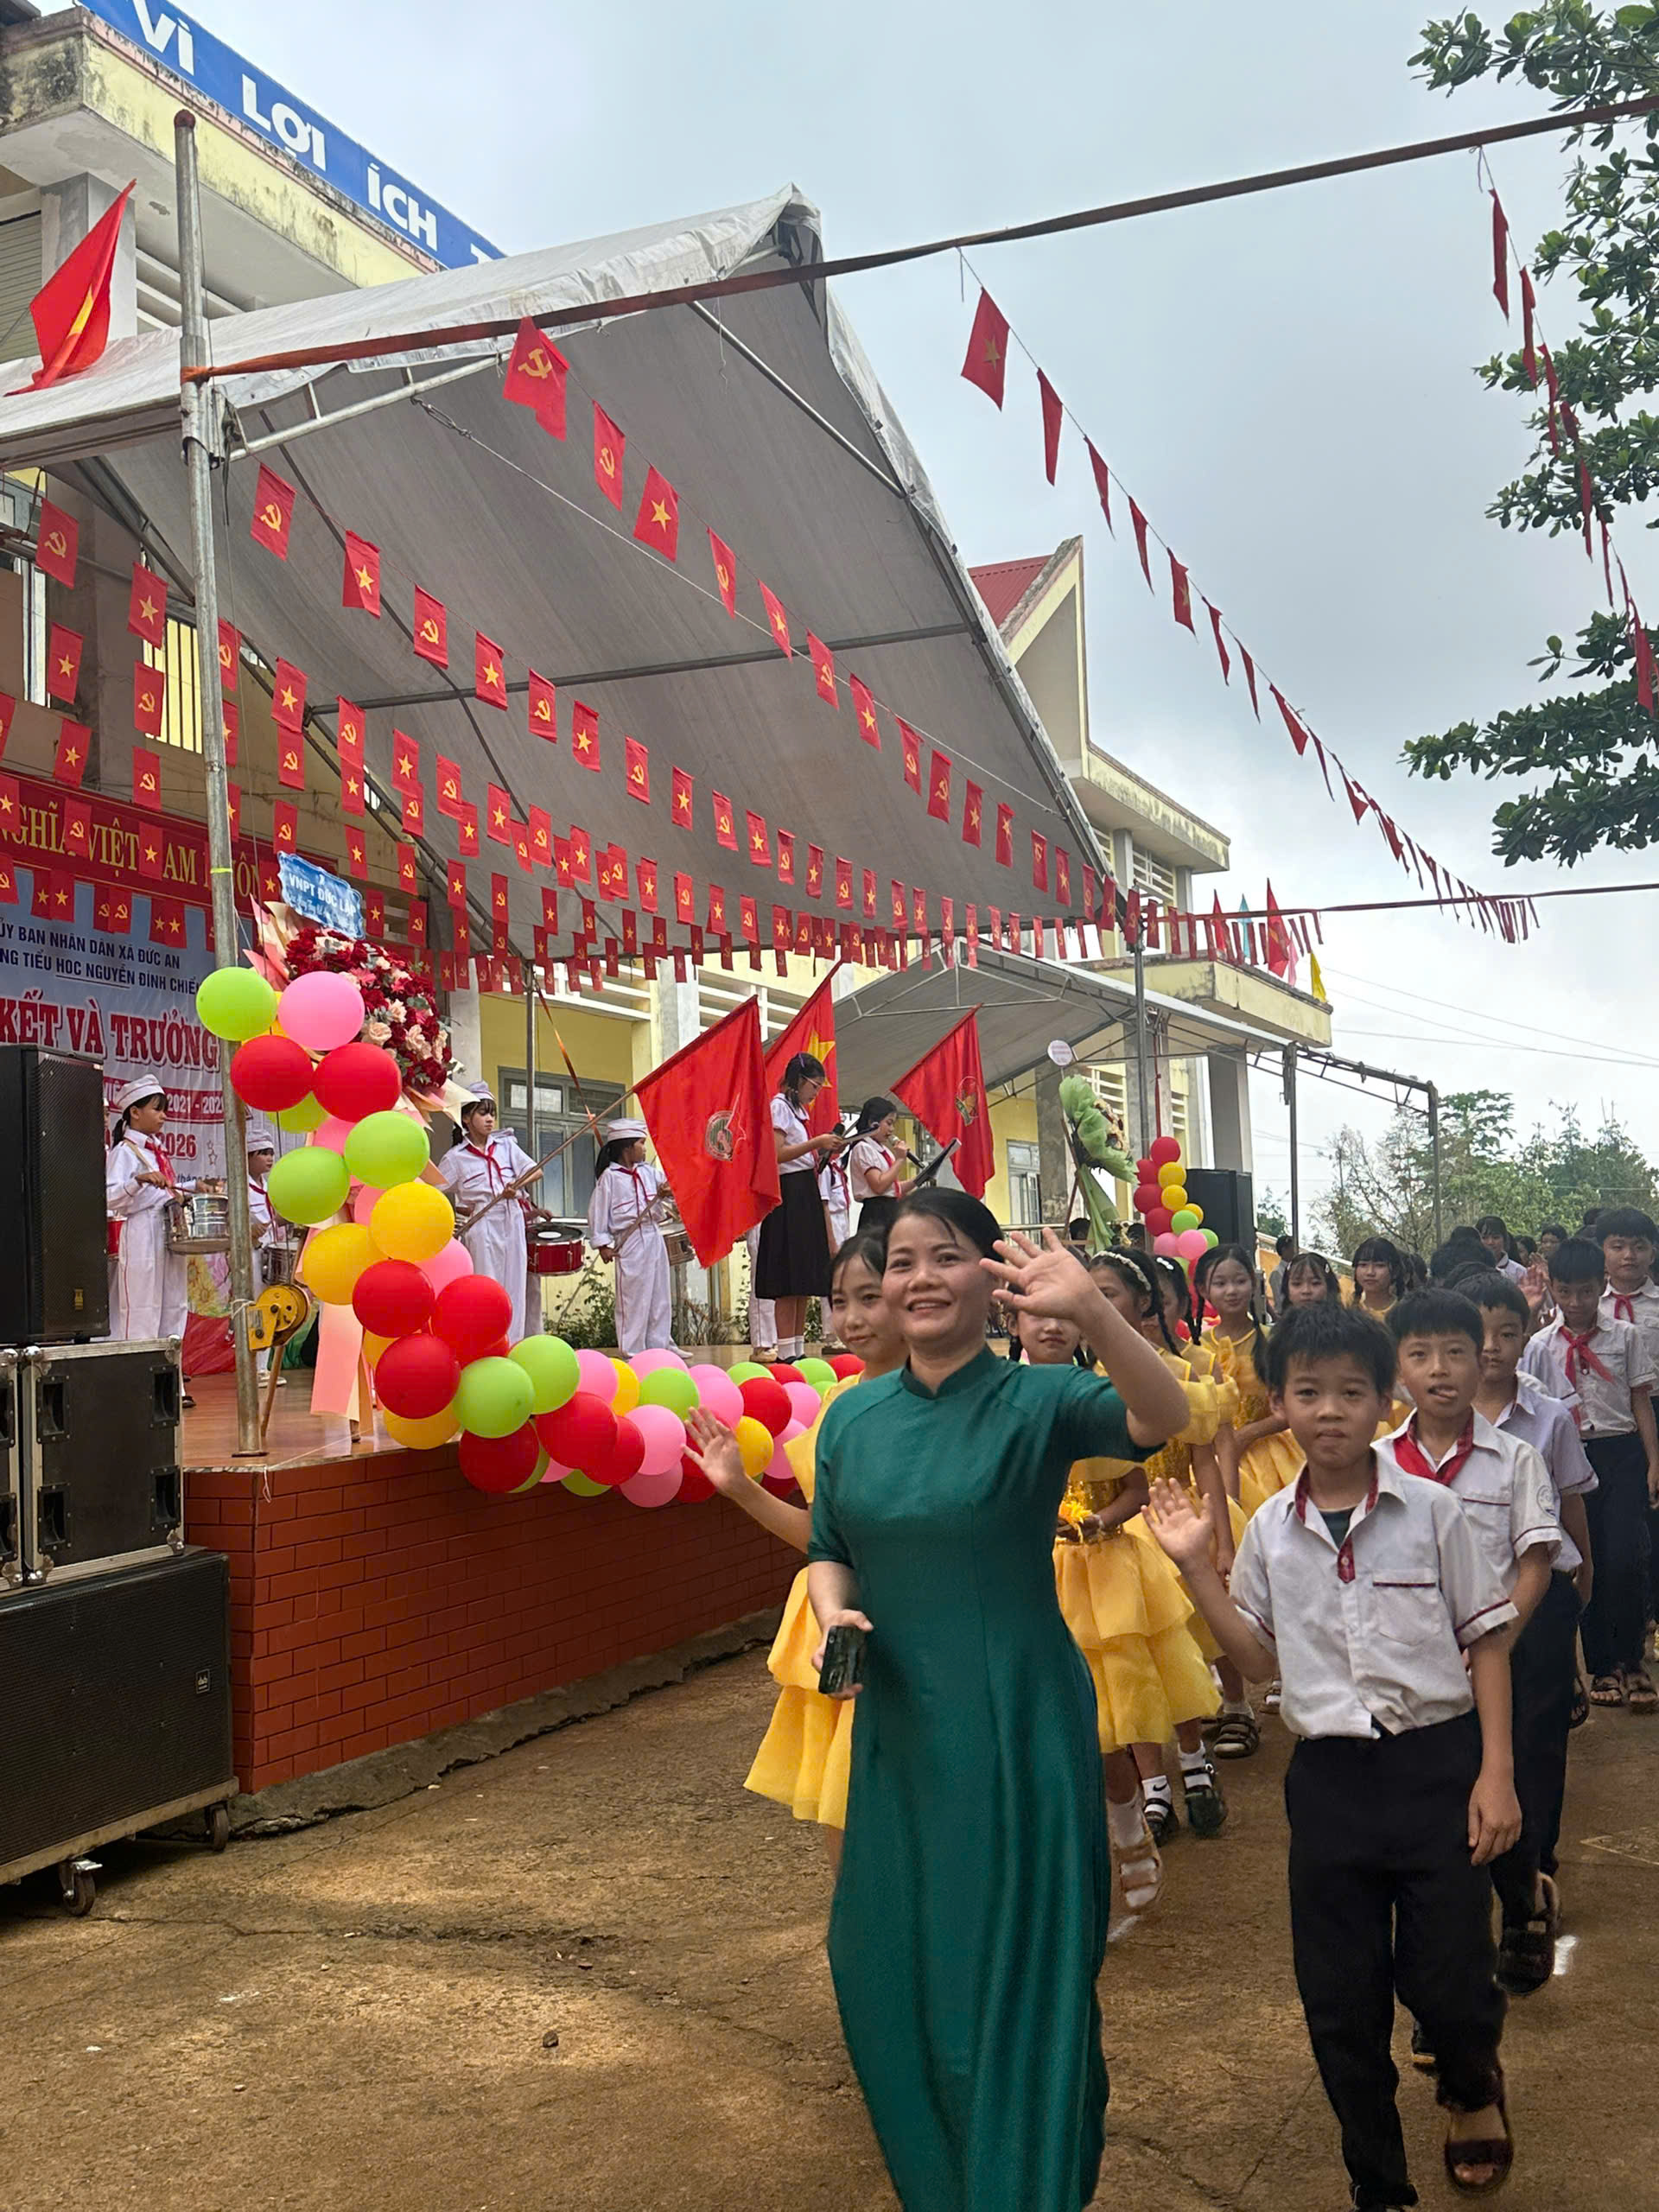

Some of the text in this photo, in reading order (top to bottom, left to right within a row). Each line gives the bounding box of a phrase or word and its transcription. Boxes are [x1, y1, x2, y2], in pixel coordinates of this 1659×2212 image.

[133, 0, 438, 251] VÌ LỢI ÍCH
[162, 842, 198, 886] AM
[289, 873, 316, 897] VNPT
[18, 925, 46, 945] BAN
[50, 932, 86, 952] NHÂN
[90, 938, 115, 958] DÂN
[138, 945, 162, 967] ĐỨC
[165, 955, 181, 970] AN
[0, 989, 219, 1070] KẾT VÀ TRƯỞNG
[168, 1094, 191, 1114] 2021
[202, 1096, 225, 1114] 202
